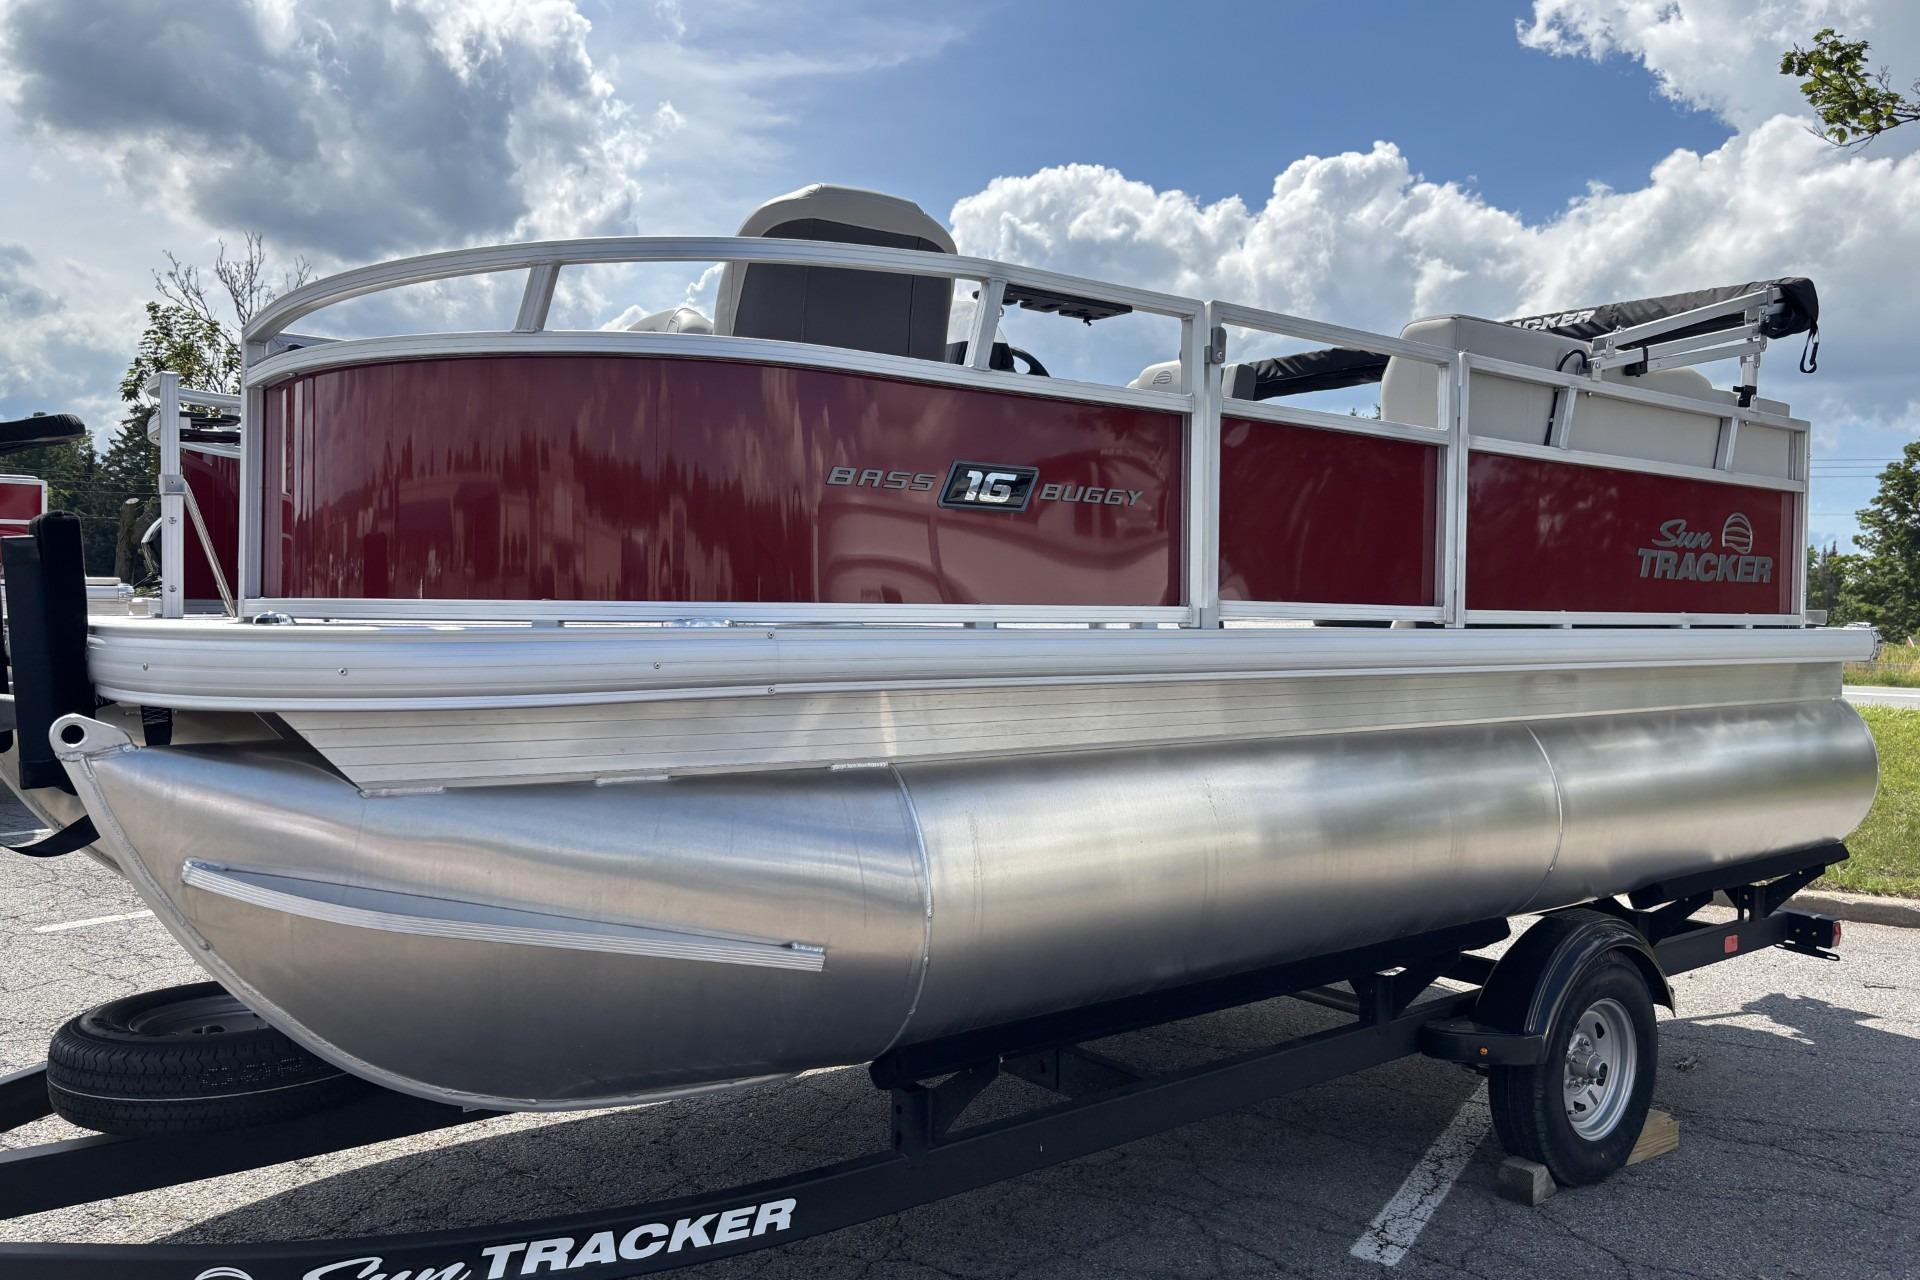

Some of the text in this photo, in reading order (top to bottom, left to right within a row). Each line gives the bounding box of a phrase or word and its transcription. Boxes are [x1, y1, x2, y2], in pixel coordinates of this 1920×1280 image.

[826, 466, 1144, 506] BASS 16 BUGGY
[1651, 518, 1713, 548] Sun
[1638, 548, 1773, 583] TRACKER
[481, 1197, 798, 1280] TRACKER
